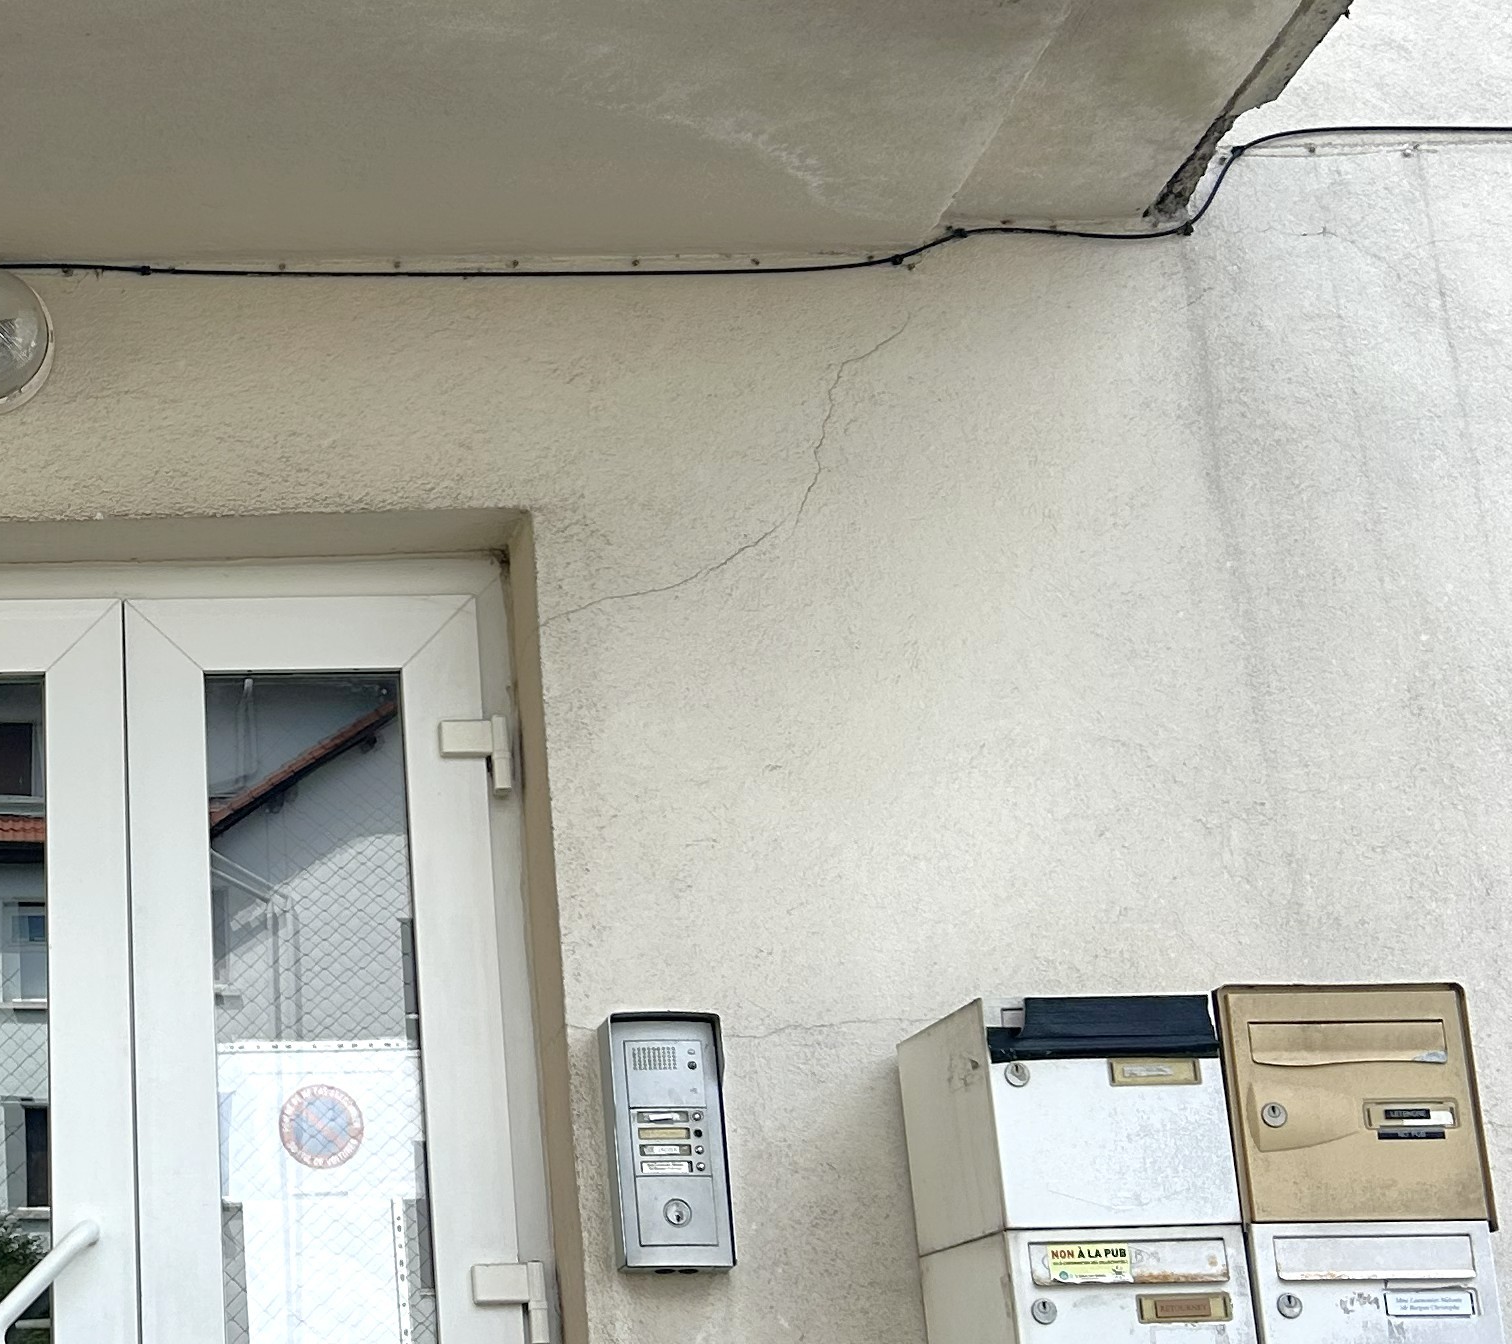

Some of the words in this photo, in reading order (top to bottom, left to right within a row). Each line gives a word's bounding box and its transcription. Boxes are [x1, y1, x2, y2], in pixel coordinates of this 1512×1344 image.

[1051, 1249, 1075, 1259] NON
[1077, 1246, 1086, 1258] À
[1087, 1248, 1102, 1258] LA
[1104, 1248, 1127, 1258] PUB
